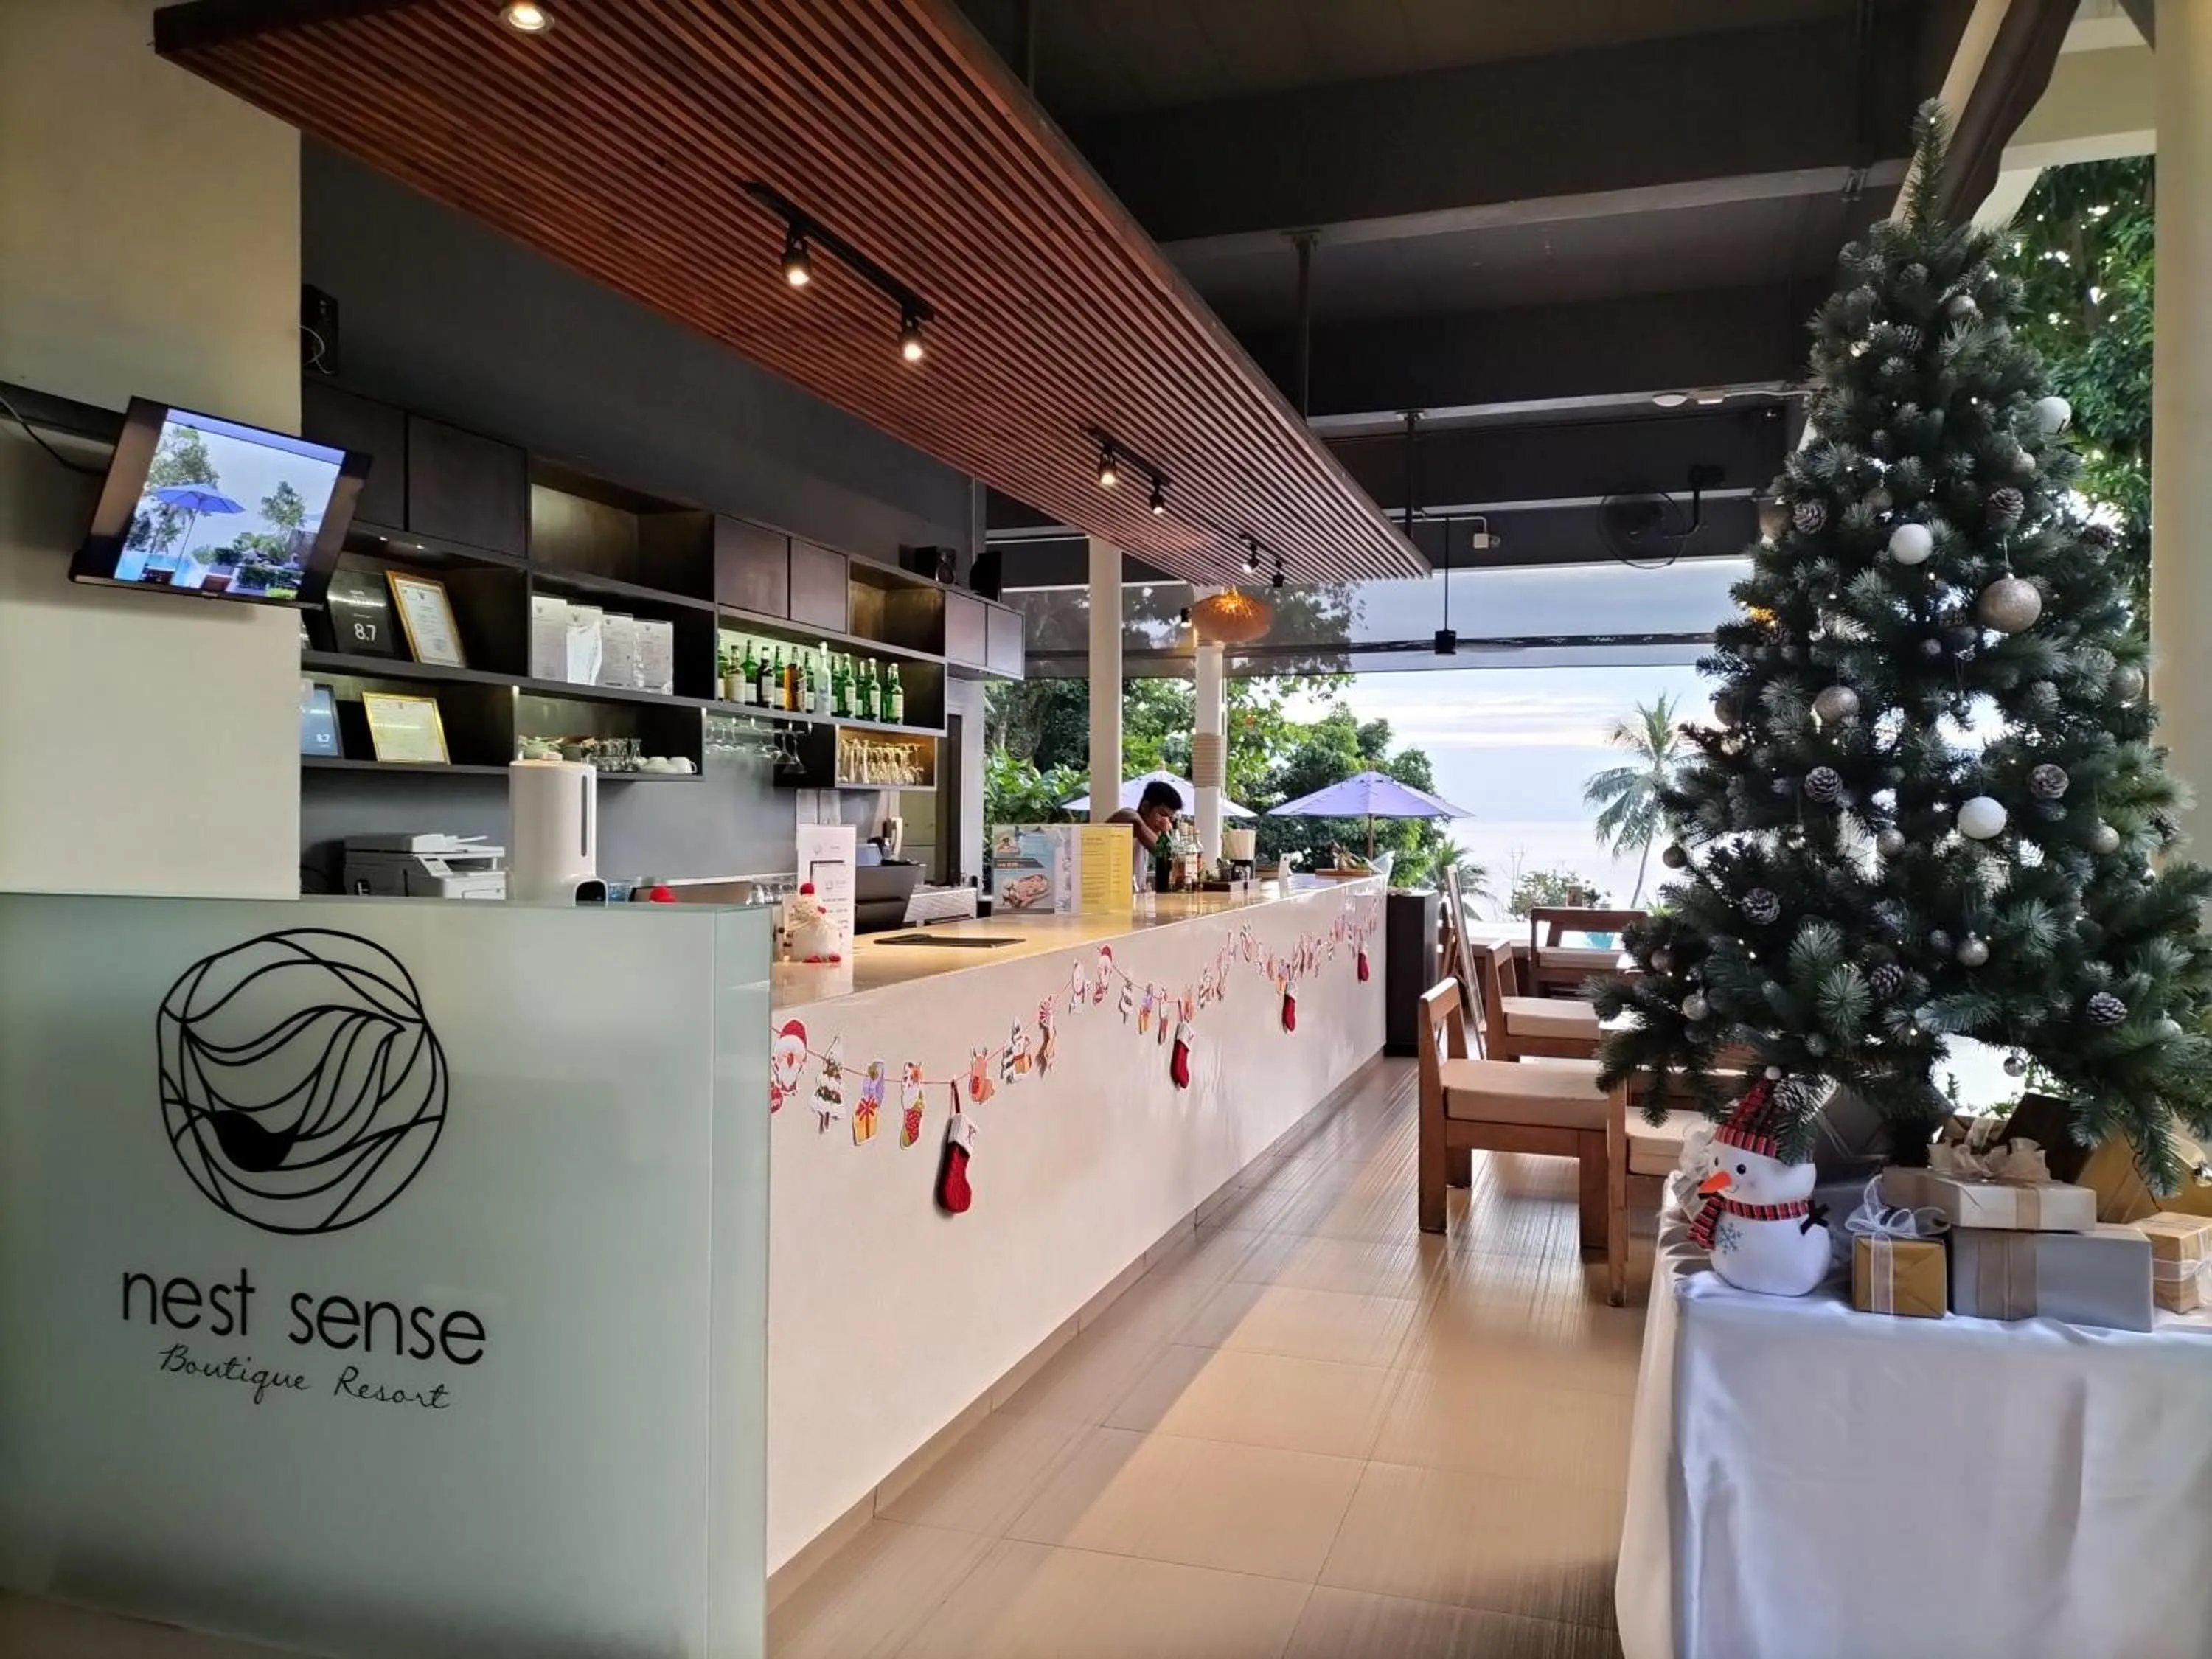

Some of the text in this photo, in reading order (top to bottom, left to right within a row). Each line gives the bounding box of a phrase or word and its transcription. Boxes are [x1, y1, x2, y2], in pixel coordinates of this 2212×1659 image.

[355, 623, 377, 641] 8.7
[122, 1267, 487, 1366] nest sense
[159, 1343, 450, 1409] Boutique Resort
